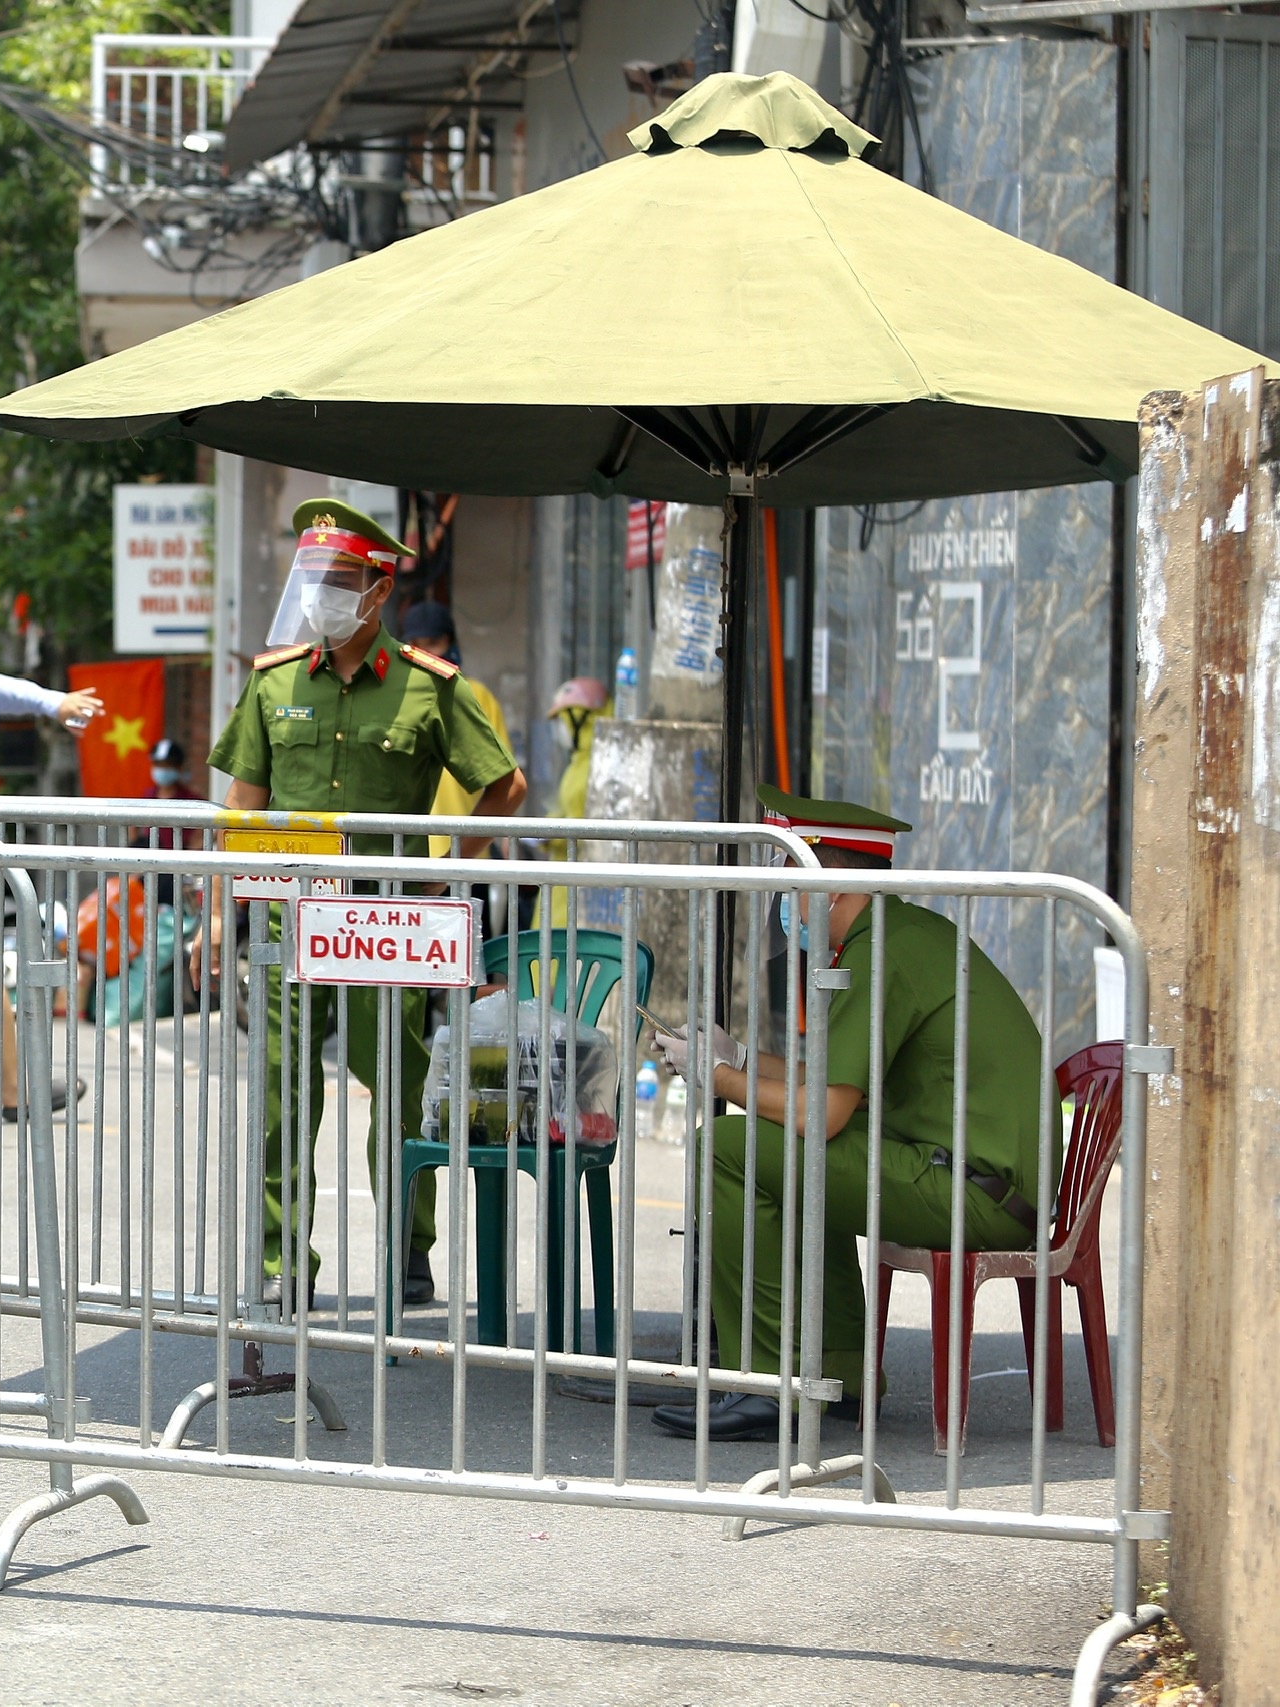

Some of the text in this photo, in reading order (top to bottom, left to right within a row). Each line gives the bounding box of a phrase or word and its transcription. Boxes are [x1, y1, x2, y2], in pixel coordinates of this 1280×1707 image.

[938, 582, 981, 750] 2
[346, 909, 422, 926] C.A.H.N
[310, 927, 457, 969] DỪNG LẠI
